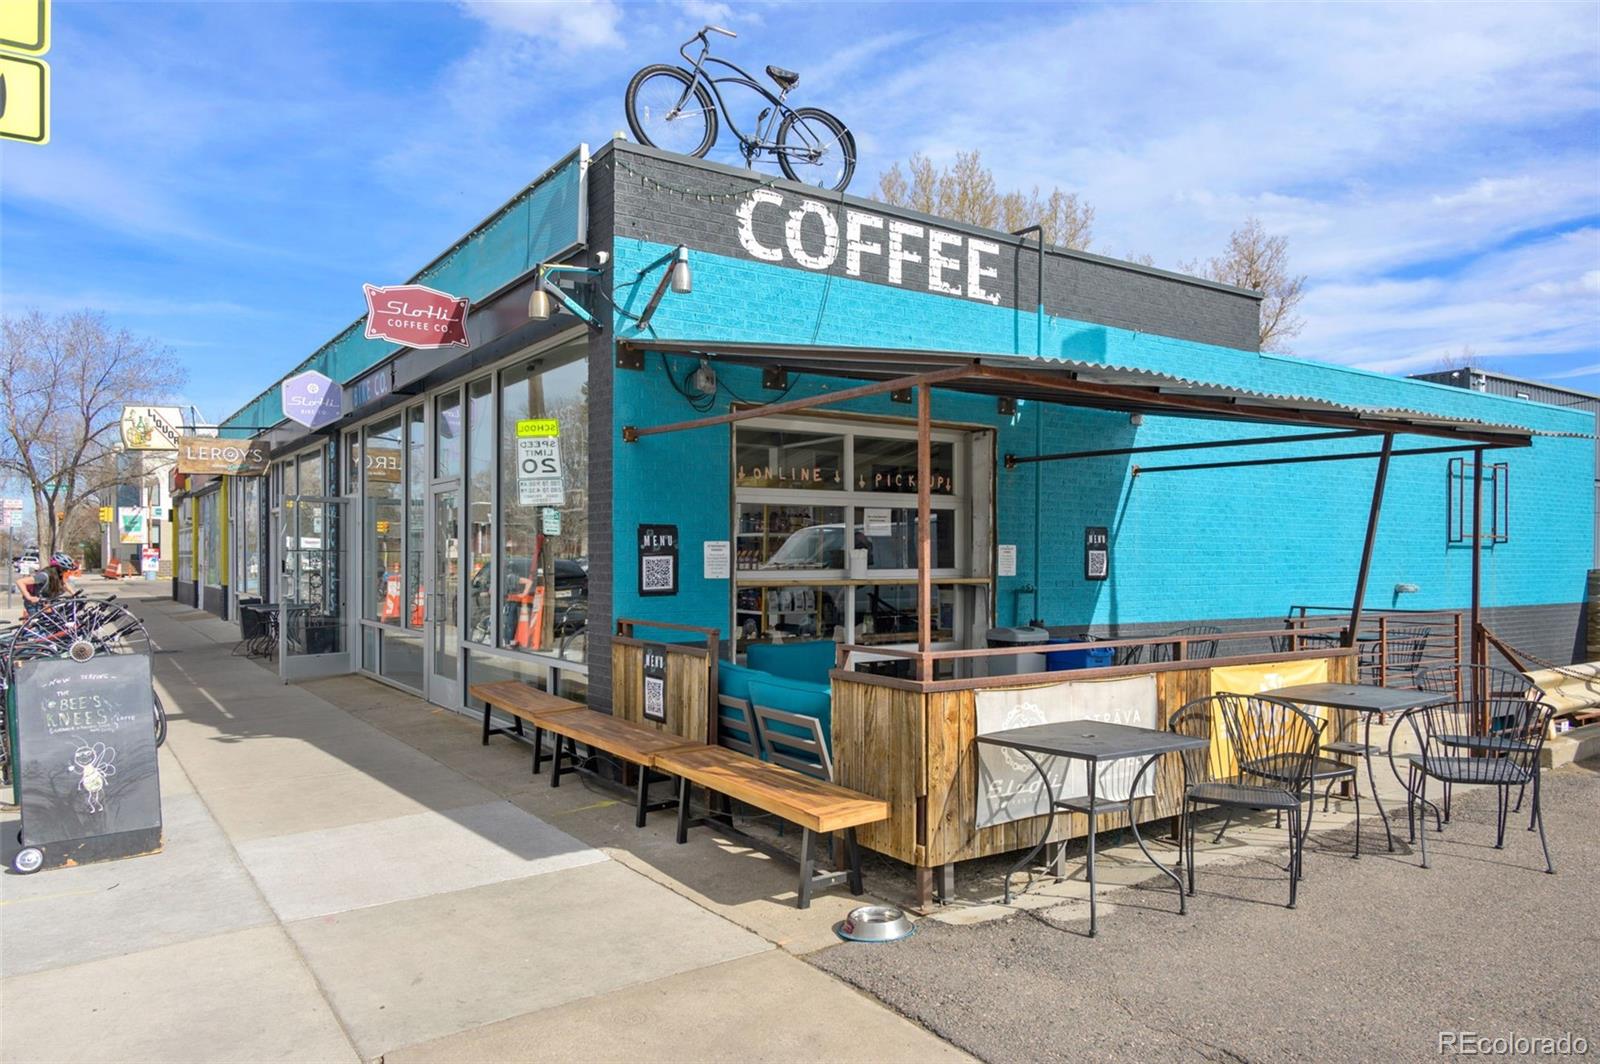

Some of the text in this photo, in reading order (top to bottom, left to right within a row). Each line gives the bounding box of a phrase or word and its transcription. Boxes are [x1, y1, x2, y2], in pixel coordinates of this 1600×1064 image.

[736, 189, 1002, 305] COFFEE
[378, 301, 459, 321] SloHi
[387, 319, 429, 331] COFFEE
[187, 447, 262, 462] LEROY'S
[753, 466, 822, 482] ONLINE
[875, 473, 916, 488] PICK
[643, 535, 673, 546] MENU
[60, 695, 101, 711] BEE'S
[46, 709, 108, 727] KNEES
